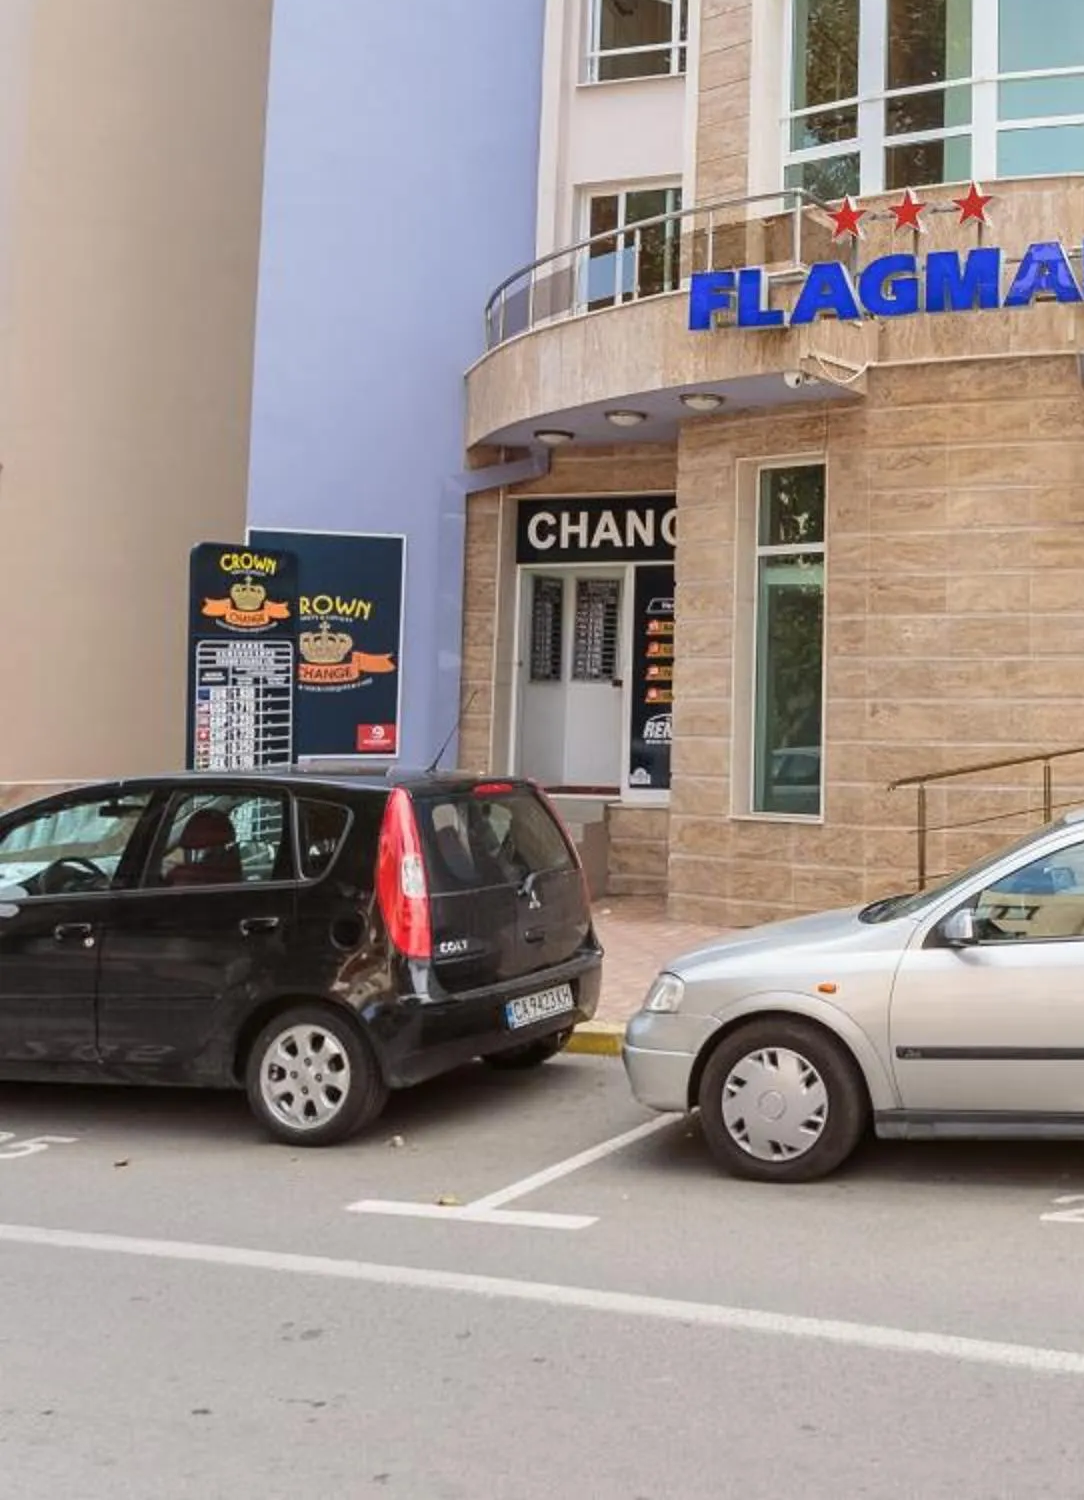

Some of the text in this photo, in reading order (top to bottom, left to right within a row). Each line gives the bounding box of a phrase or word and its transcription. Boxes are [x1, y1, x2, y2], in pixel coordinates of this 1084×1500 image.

[220, 553, 277, 576] CROWN
[299, 595, 371, 620] ROWN
[440, 939, 468, 953] COLT
[0, 1131, 80, 1159] 5
